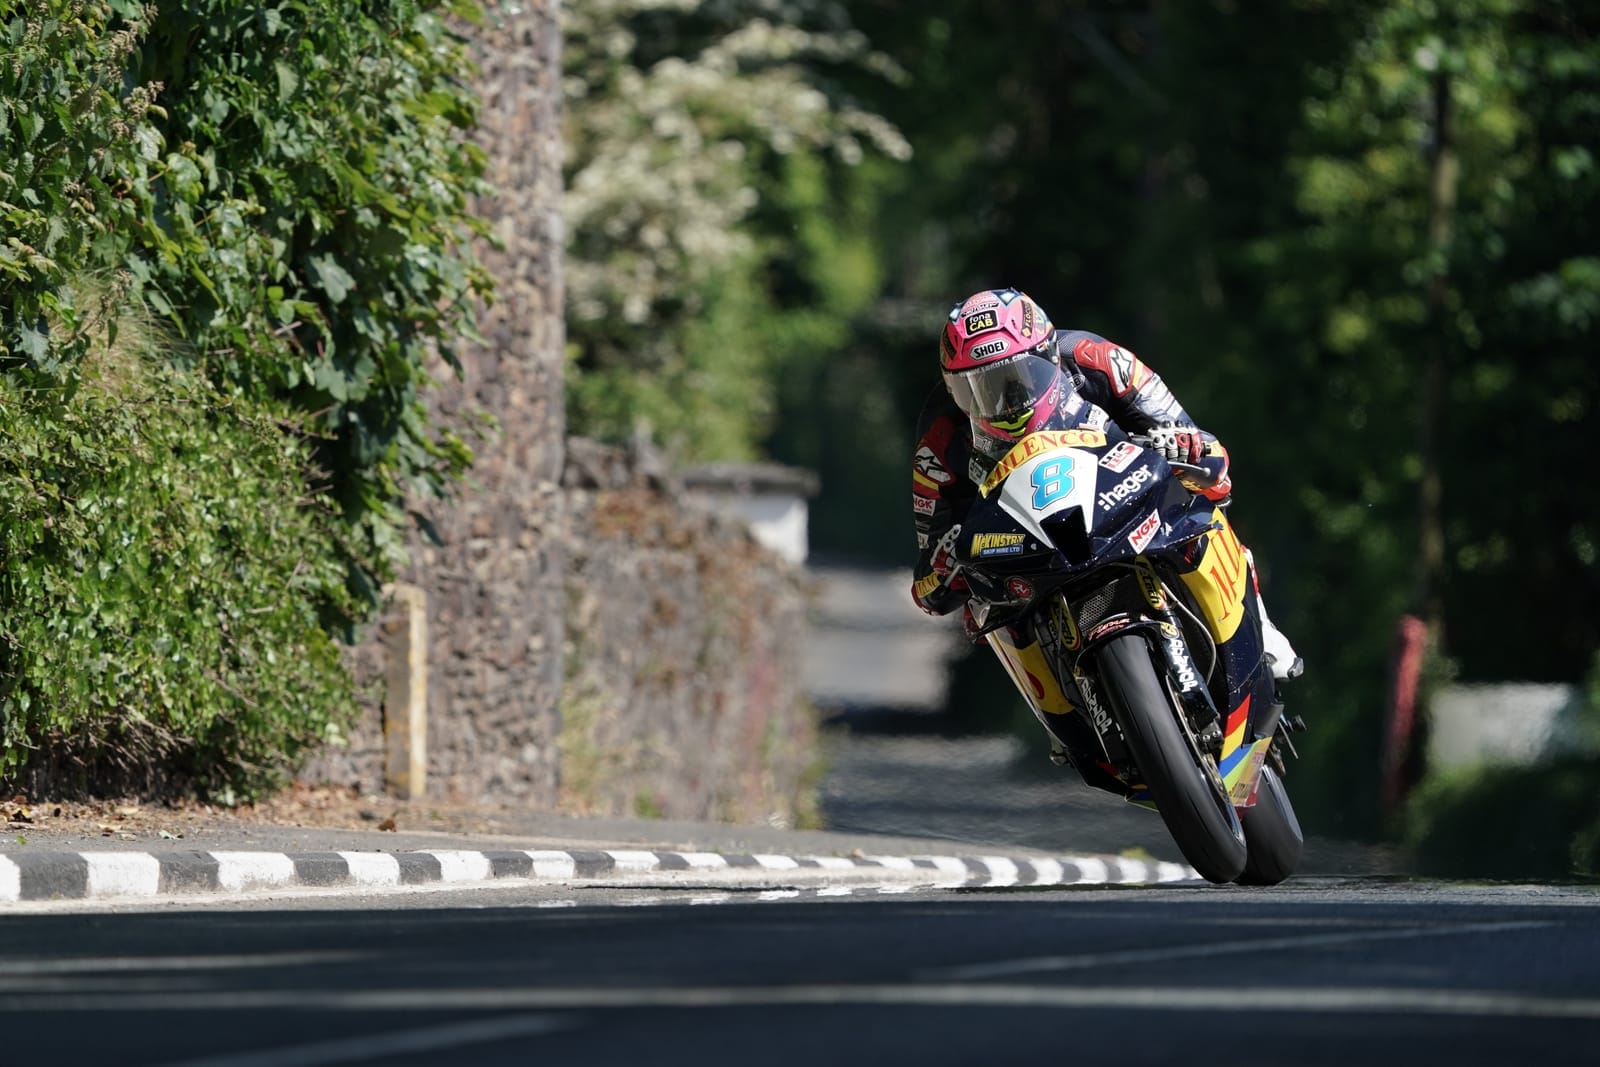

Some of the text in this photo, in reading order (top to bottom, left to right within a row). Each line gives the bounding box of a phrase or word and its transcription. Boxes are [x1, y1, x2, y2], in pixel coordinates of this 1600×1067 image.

[969, 313, 991, 324] fona
[969, 319, 994, 332] CAB
[973, 341, 1005, 358] SHOEI
[1031, 455, 1075, 511] 8
[1131, 515, 1158, 546] NGK
